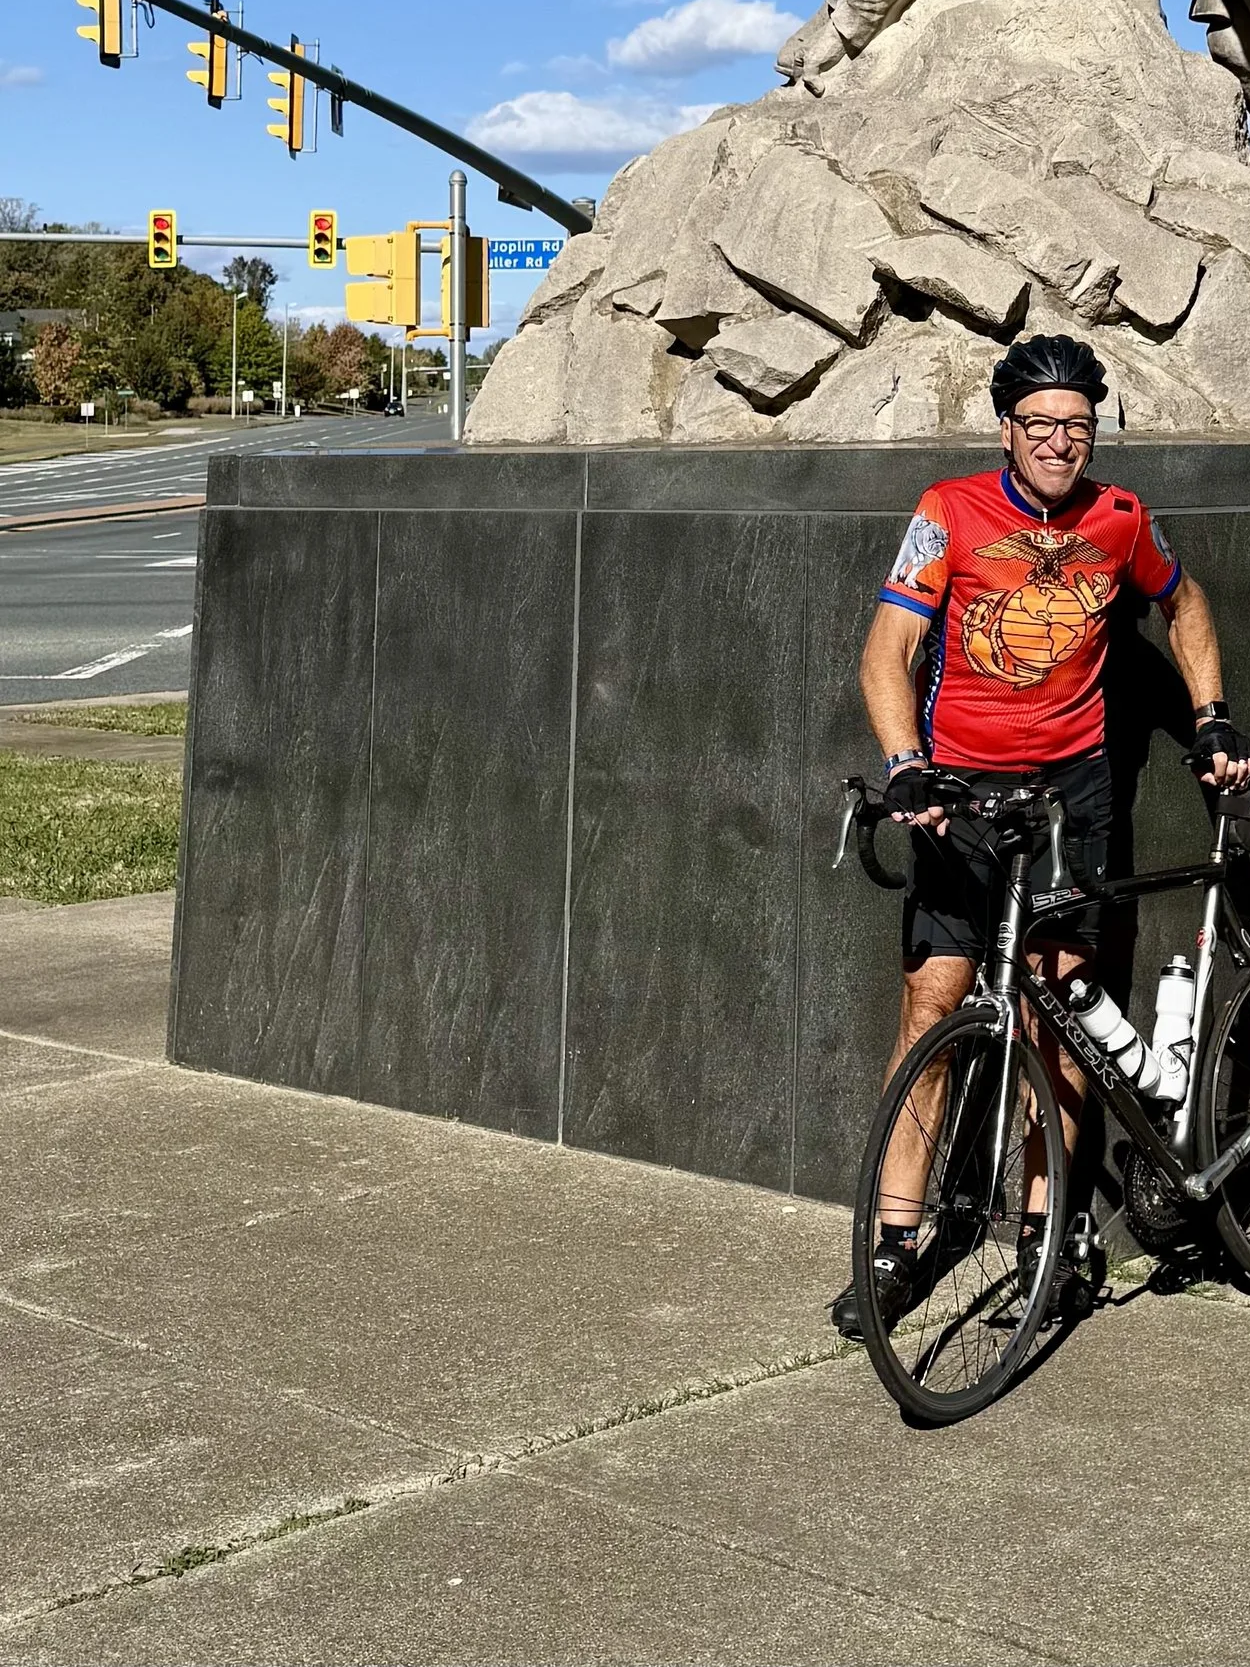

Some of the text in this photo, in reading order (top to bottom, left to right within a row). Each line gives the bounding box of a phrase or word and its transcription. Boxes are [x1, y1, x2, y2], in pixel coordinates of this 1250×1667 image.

[492, 240, 560, 254] Joplin Rd
[525, 256, 543, 268] Rd
[1039, 990, 1119, 1090] TREK
